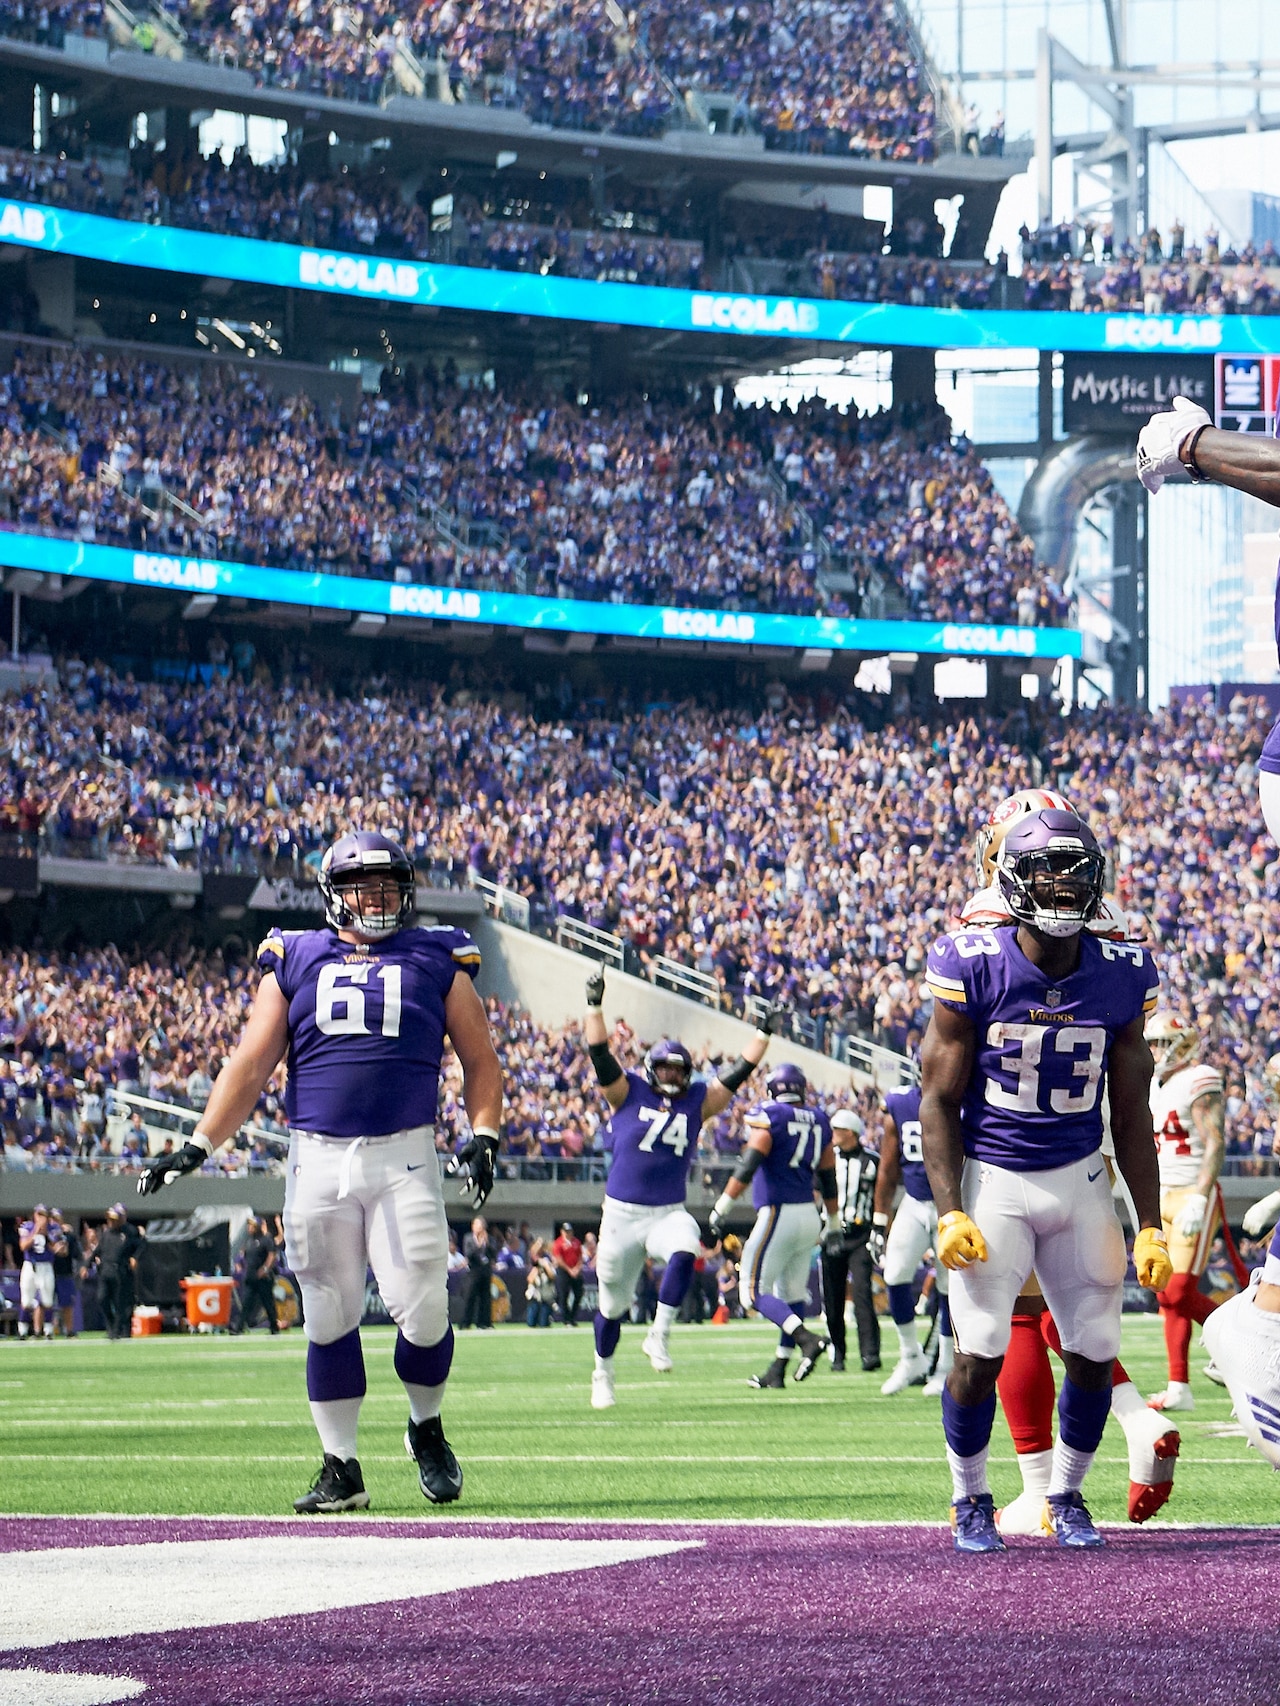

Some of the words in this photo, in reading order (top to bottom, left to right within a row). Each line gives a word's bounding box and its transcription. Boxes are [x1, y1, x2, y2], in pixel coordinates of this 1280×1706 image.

[300, 252, 418, 296] ECOLAB
[692, 296, 818, 333] ECOLAB
[1105, 318, 1222, 346] ECOLAB
[133, 553, 217, 590] ECOLAB
[389, 585, 481, 619] ECOLAB
[662, 609, 755, 640] ECOLAB
[942, 625, 1037, 654] ECOLAB
[315, 962, 402, 1038] 61
[984, 1021, 1107, 1115] 33
[638, 1105, 690, 1157] 74
[787, 1121, 822, 1169] 71
[197, 1288, 220, 1316] G
